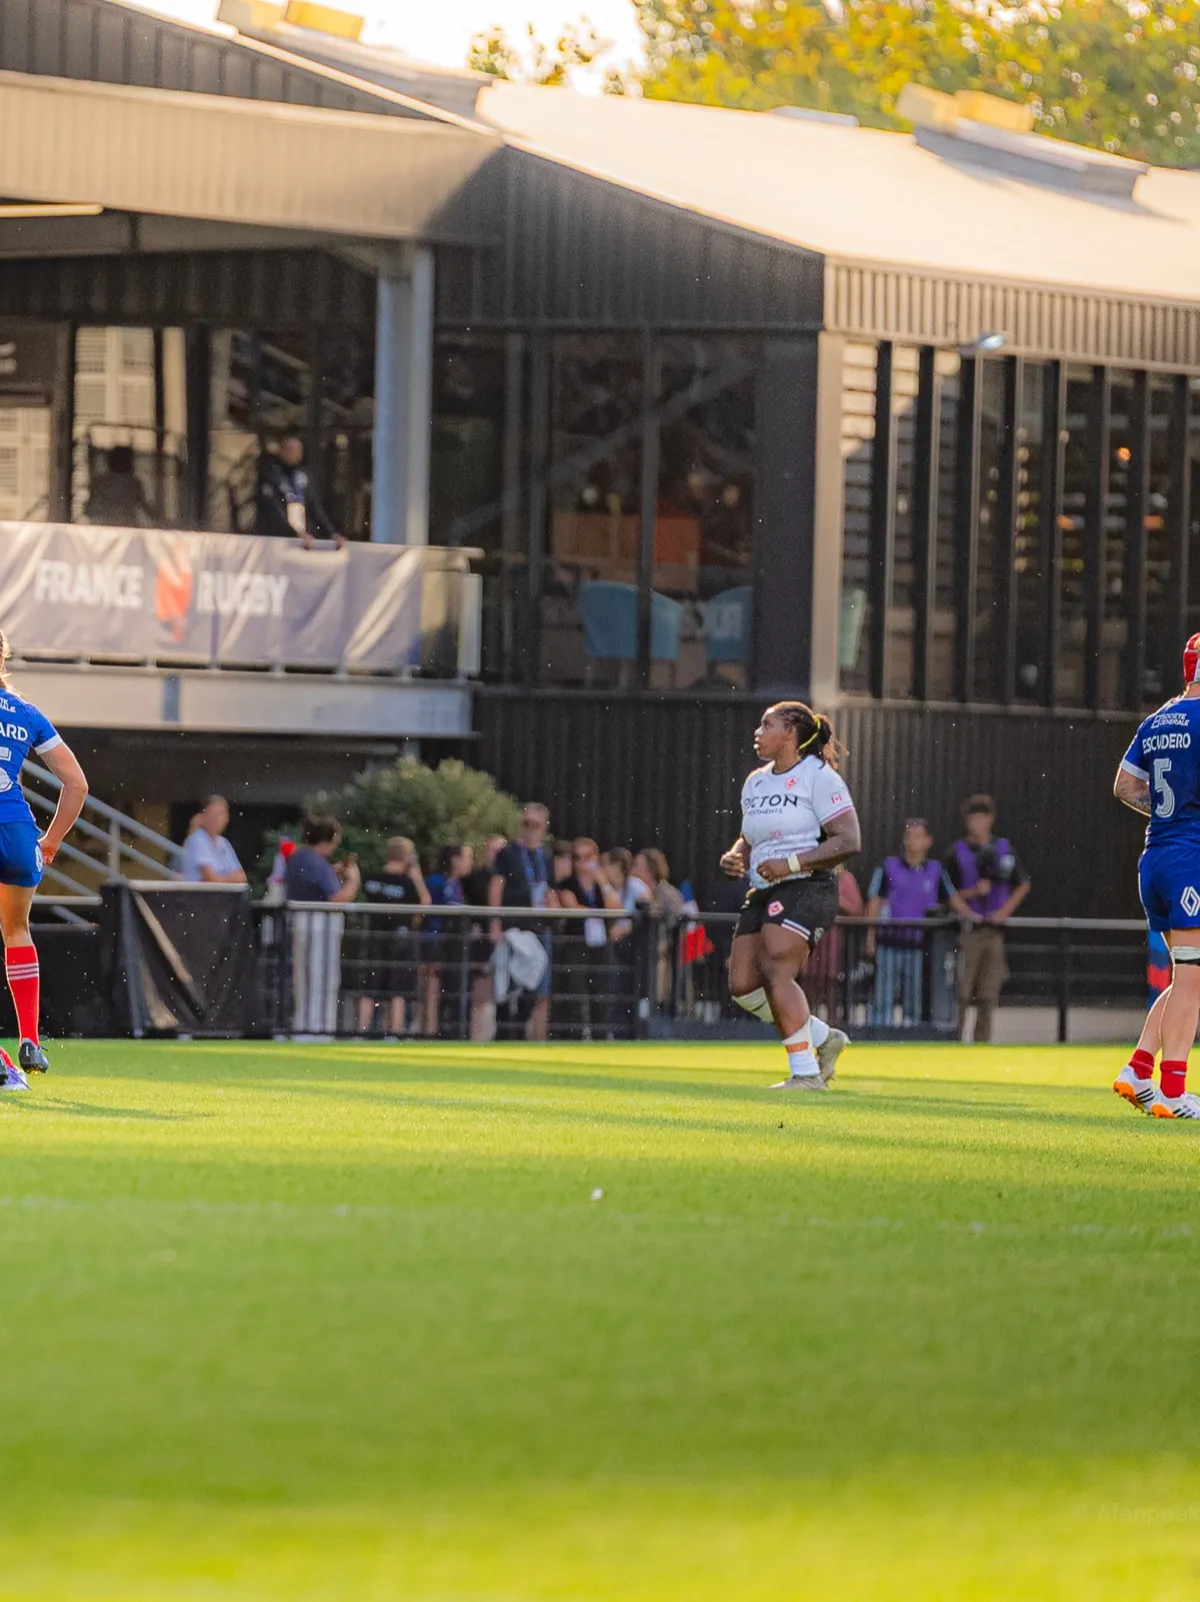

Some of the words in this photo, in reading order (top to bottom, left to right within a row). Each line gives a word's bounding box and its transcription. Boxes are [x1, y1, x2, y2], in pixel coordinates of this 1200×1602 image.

[35, 559, 144, 609] FRANCE
[198, 571, 289, 617] RUGBY
[1142, 732, 1192, 754] ESCUDERO
[1153, 757, 1176, 819] 5
